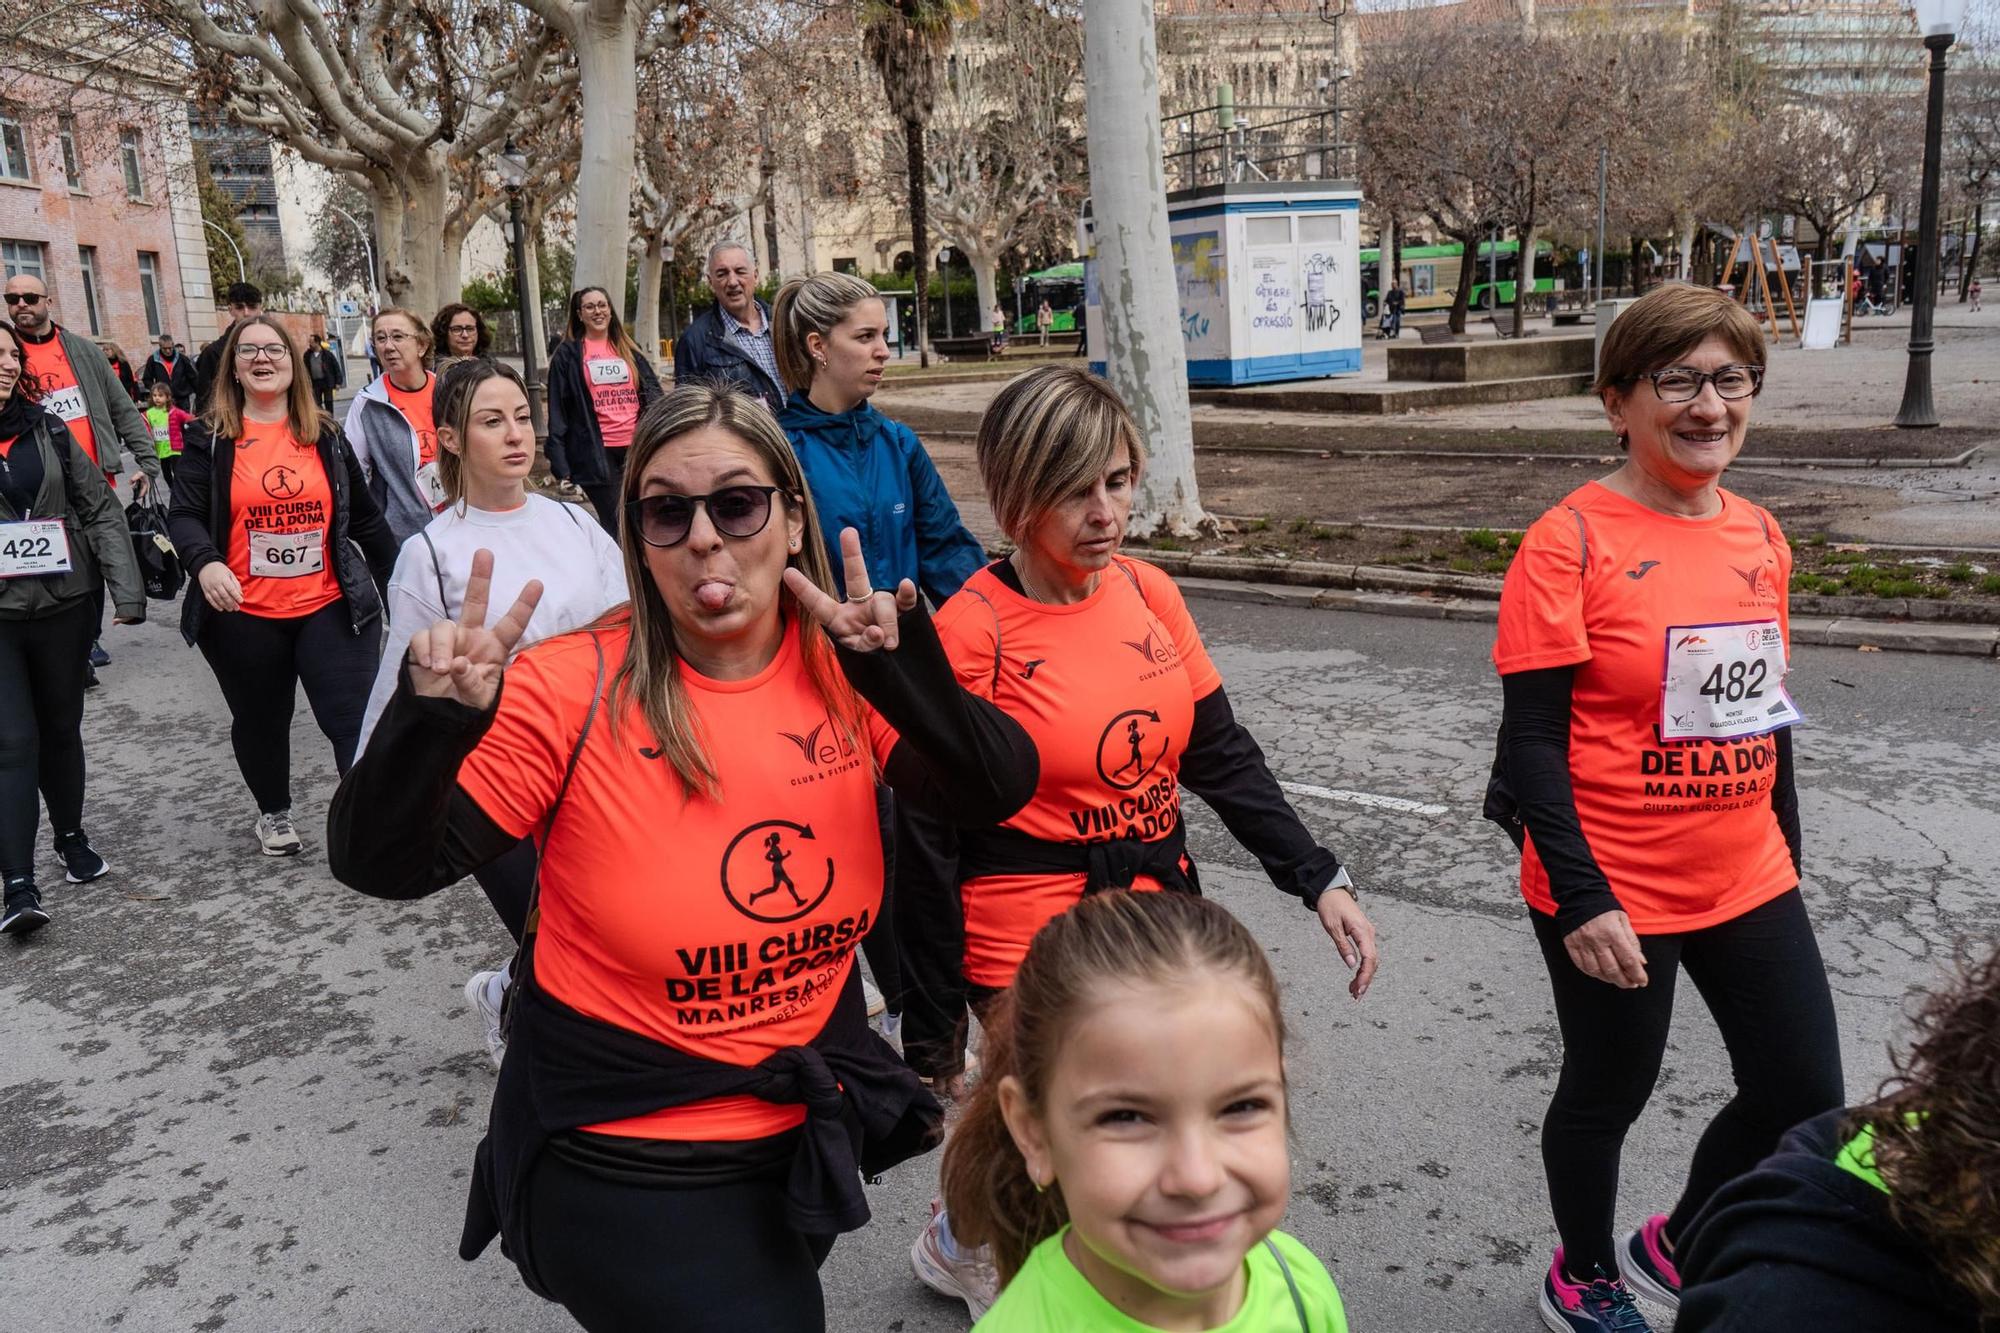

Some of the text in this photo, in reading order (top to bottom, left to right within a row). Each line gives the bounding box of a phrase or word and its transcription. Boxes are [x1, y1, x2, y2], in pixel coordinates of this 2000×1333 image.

[597, 365, 620, 376] 750
[594, 399, 606, 407] DE
[607, 398, 616, 406] LA
[247, 500, 323, 518] VIII CURSA
[244, 517, 265, 530] DE
[267, 516, 284, 528] LA
[287, 512, 325, 525] DONA
[2, 537, 52, 559] 422
[266, 546, 308, 565] 667
[1700, 658, 1767, 704] 482
[1641, 750, 1684, 776] DE
[1691, 750, 1730, 776] LA
[790, 774, 814, 786] CLUB
[1142, 796, 1179, 838] DON
[1643, 802, 1687, 813] CIUTAT
[1069, 803, 1118, 836] VIII
[675, 909, 869, 977] VIII CURSA
[665, 978, 721, 1003] DE
[731, 967, 775, 997] LA
